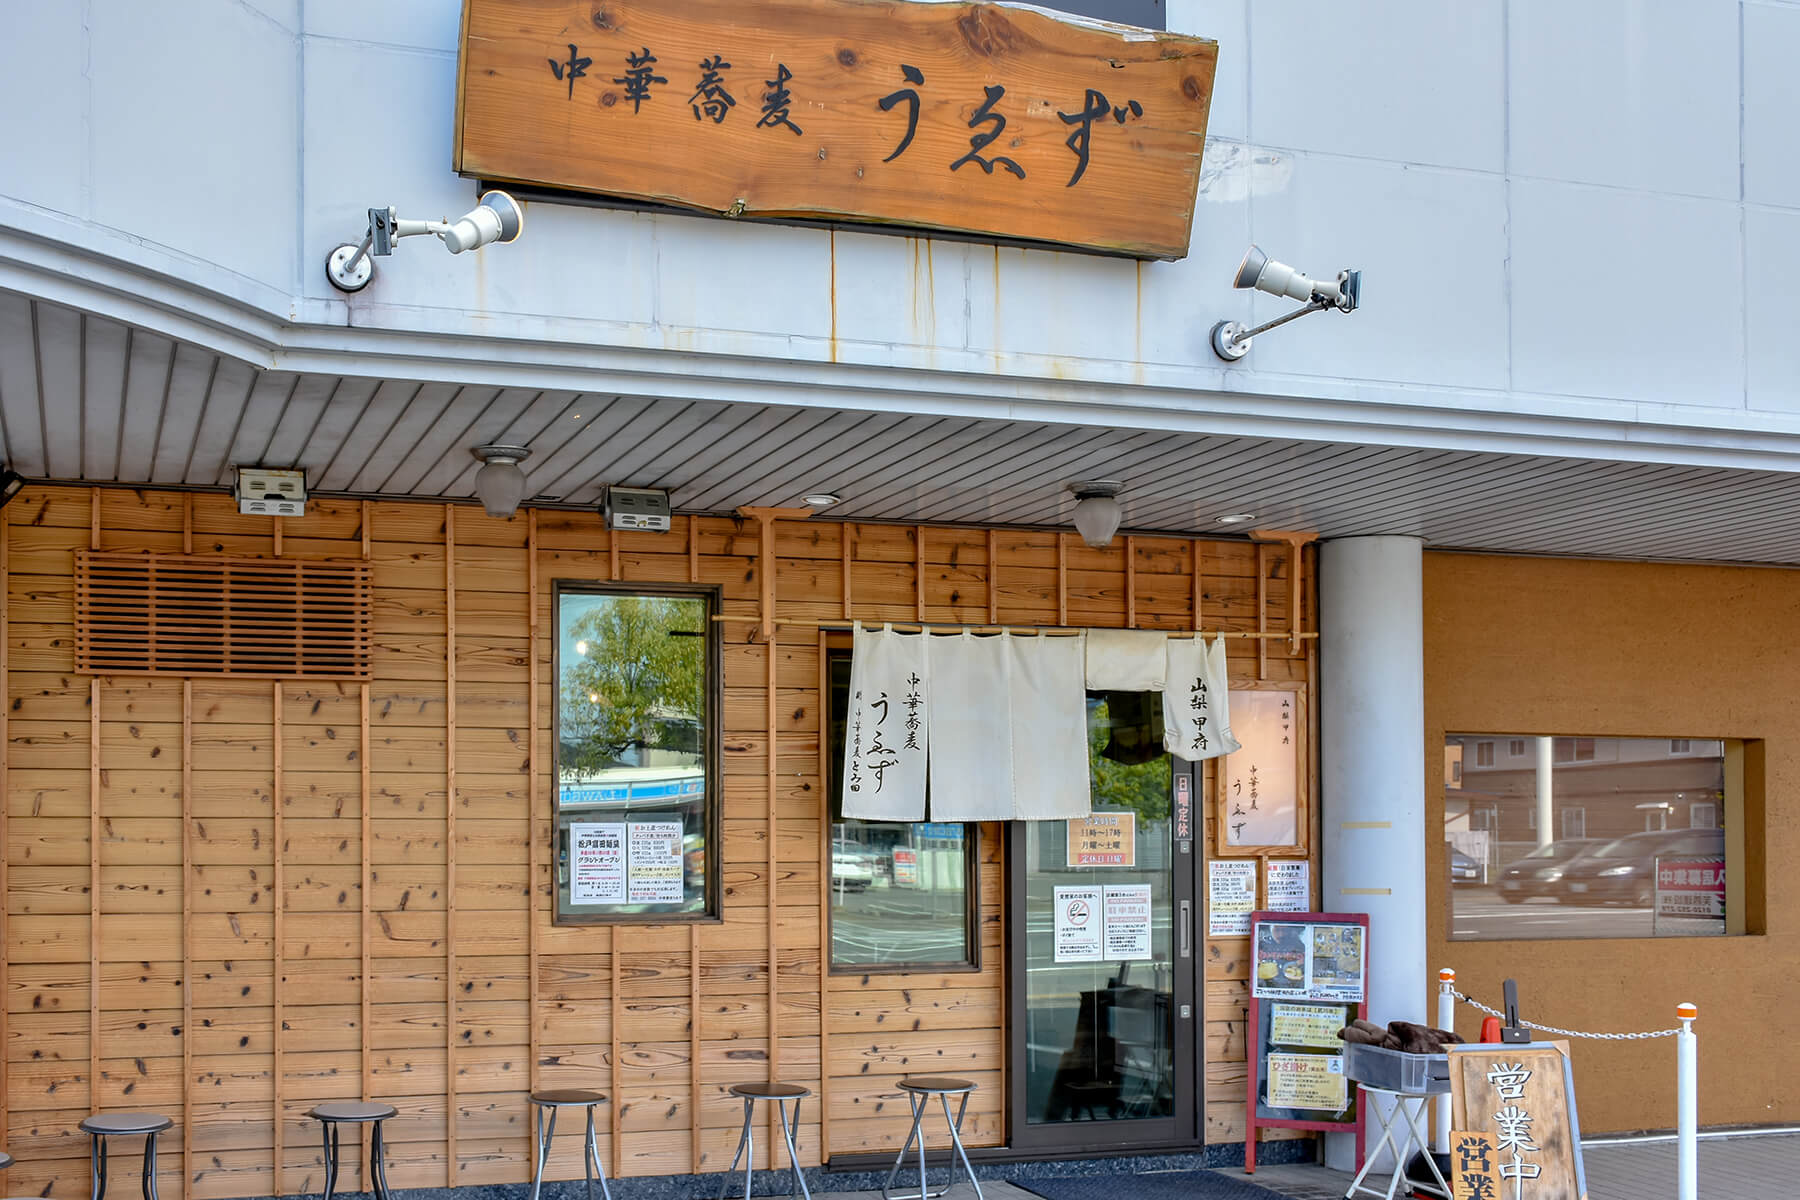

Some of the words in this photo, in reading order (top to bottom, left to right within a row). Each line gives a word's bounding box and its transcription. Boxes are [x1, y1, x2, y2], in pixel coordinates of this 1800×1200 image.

[548, 43, 803, 136] 中華蕎麦
[878, 63, 1144, 188] うゑず
[866, 691, 899, 794] うゑず
[902, 672, 924, 750] 中華蕎麦
[1177, 777, 1189, 837] 日曜定休
[1486, 1062, 1542, 1200] 営業中
